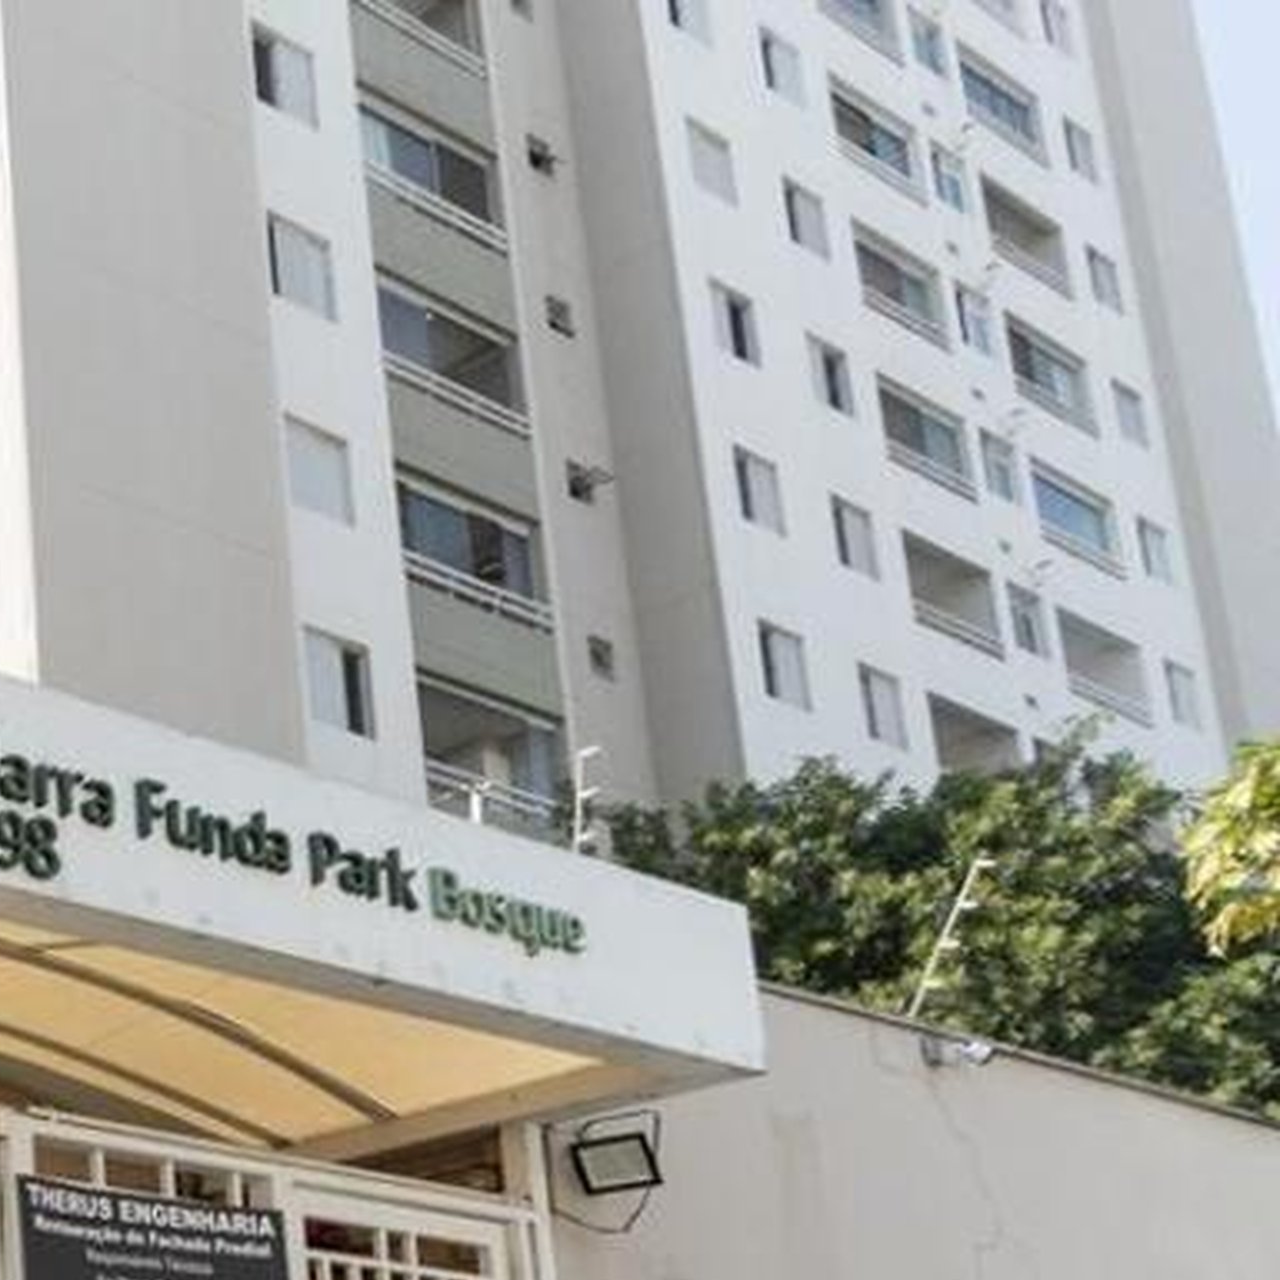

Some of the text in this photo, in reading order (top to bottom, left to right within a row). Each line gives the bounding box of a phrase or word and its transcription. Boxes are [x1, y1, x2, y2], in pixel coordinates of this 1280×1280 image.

[133, 778, 292, 877] Funda
[306, 829, 419, 912] Park
[425, 865, 588, 957] Bosque
[25, 1181, 276, 1238] THERUS ENGENHARIA
